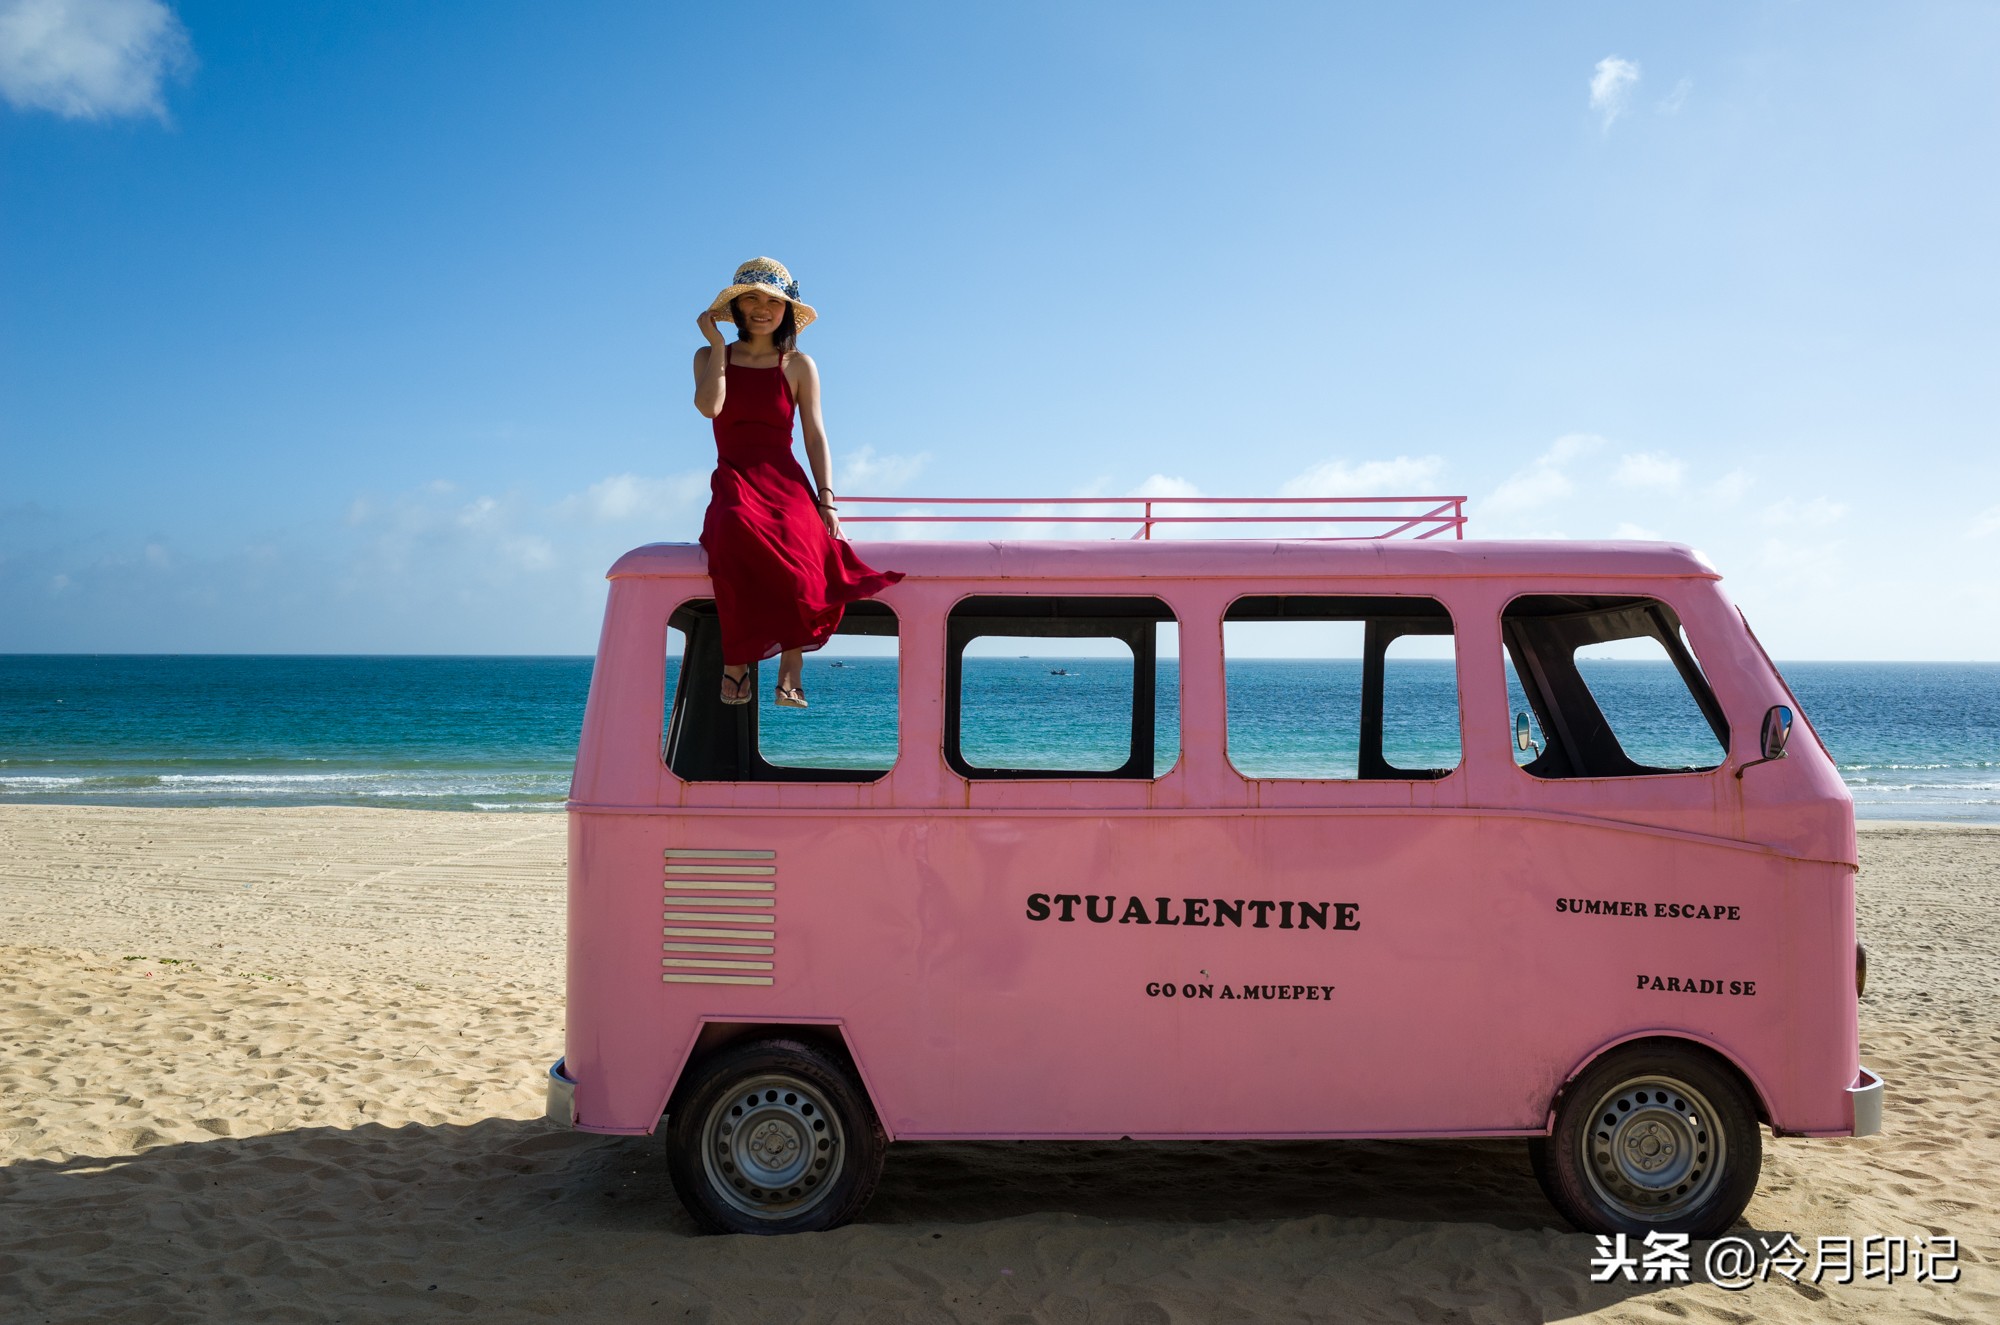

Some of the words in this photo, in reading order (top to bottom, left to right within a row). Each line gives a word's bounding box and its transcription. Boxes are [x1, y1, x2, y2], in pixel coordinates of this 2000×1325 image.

[1025, 892, 1361, 931] STUALENTINE
[1555, 897, 1649, 918] SUMMER
[1653, 902, 1741, 921] ESCAPE
[1145, 982, 1177, 998] GO
[1182, 983, 1214, 999] ON
